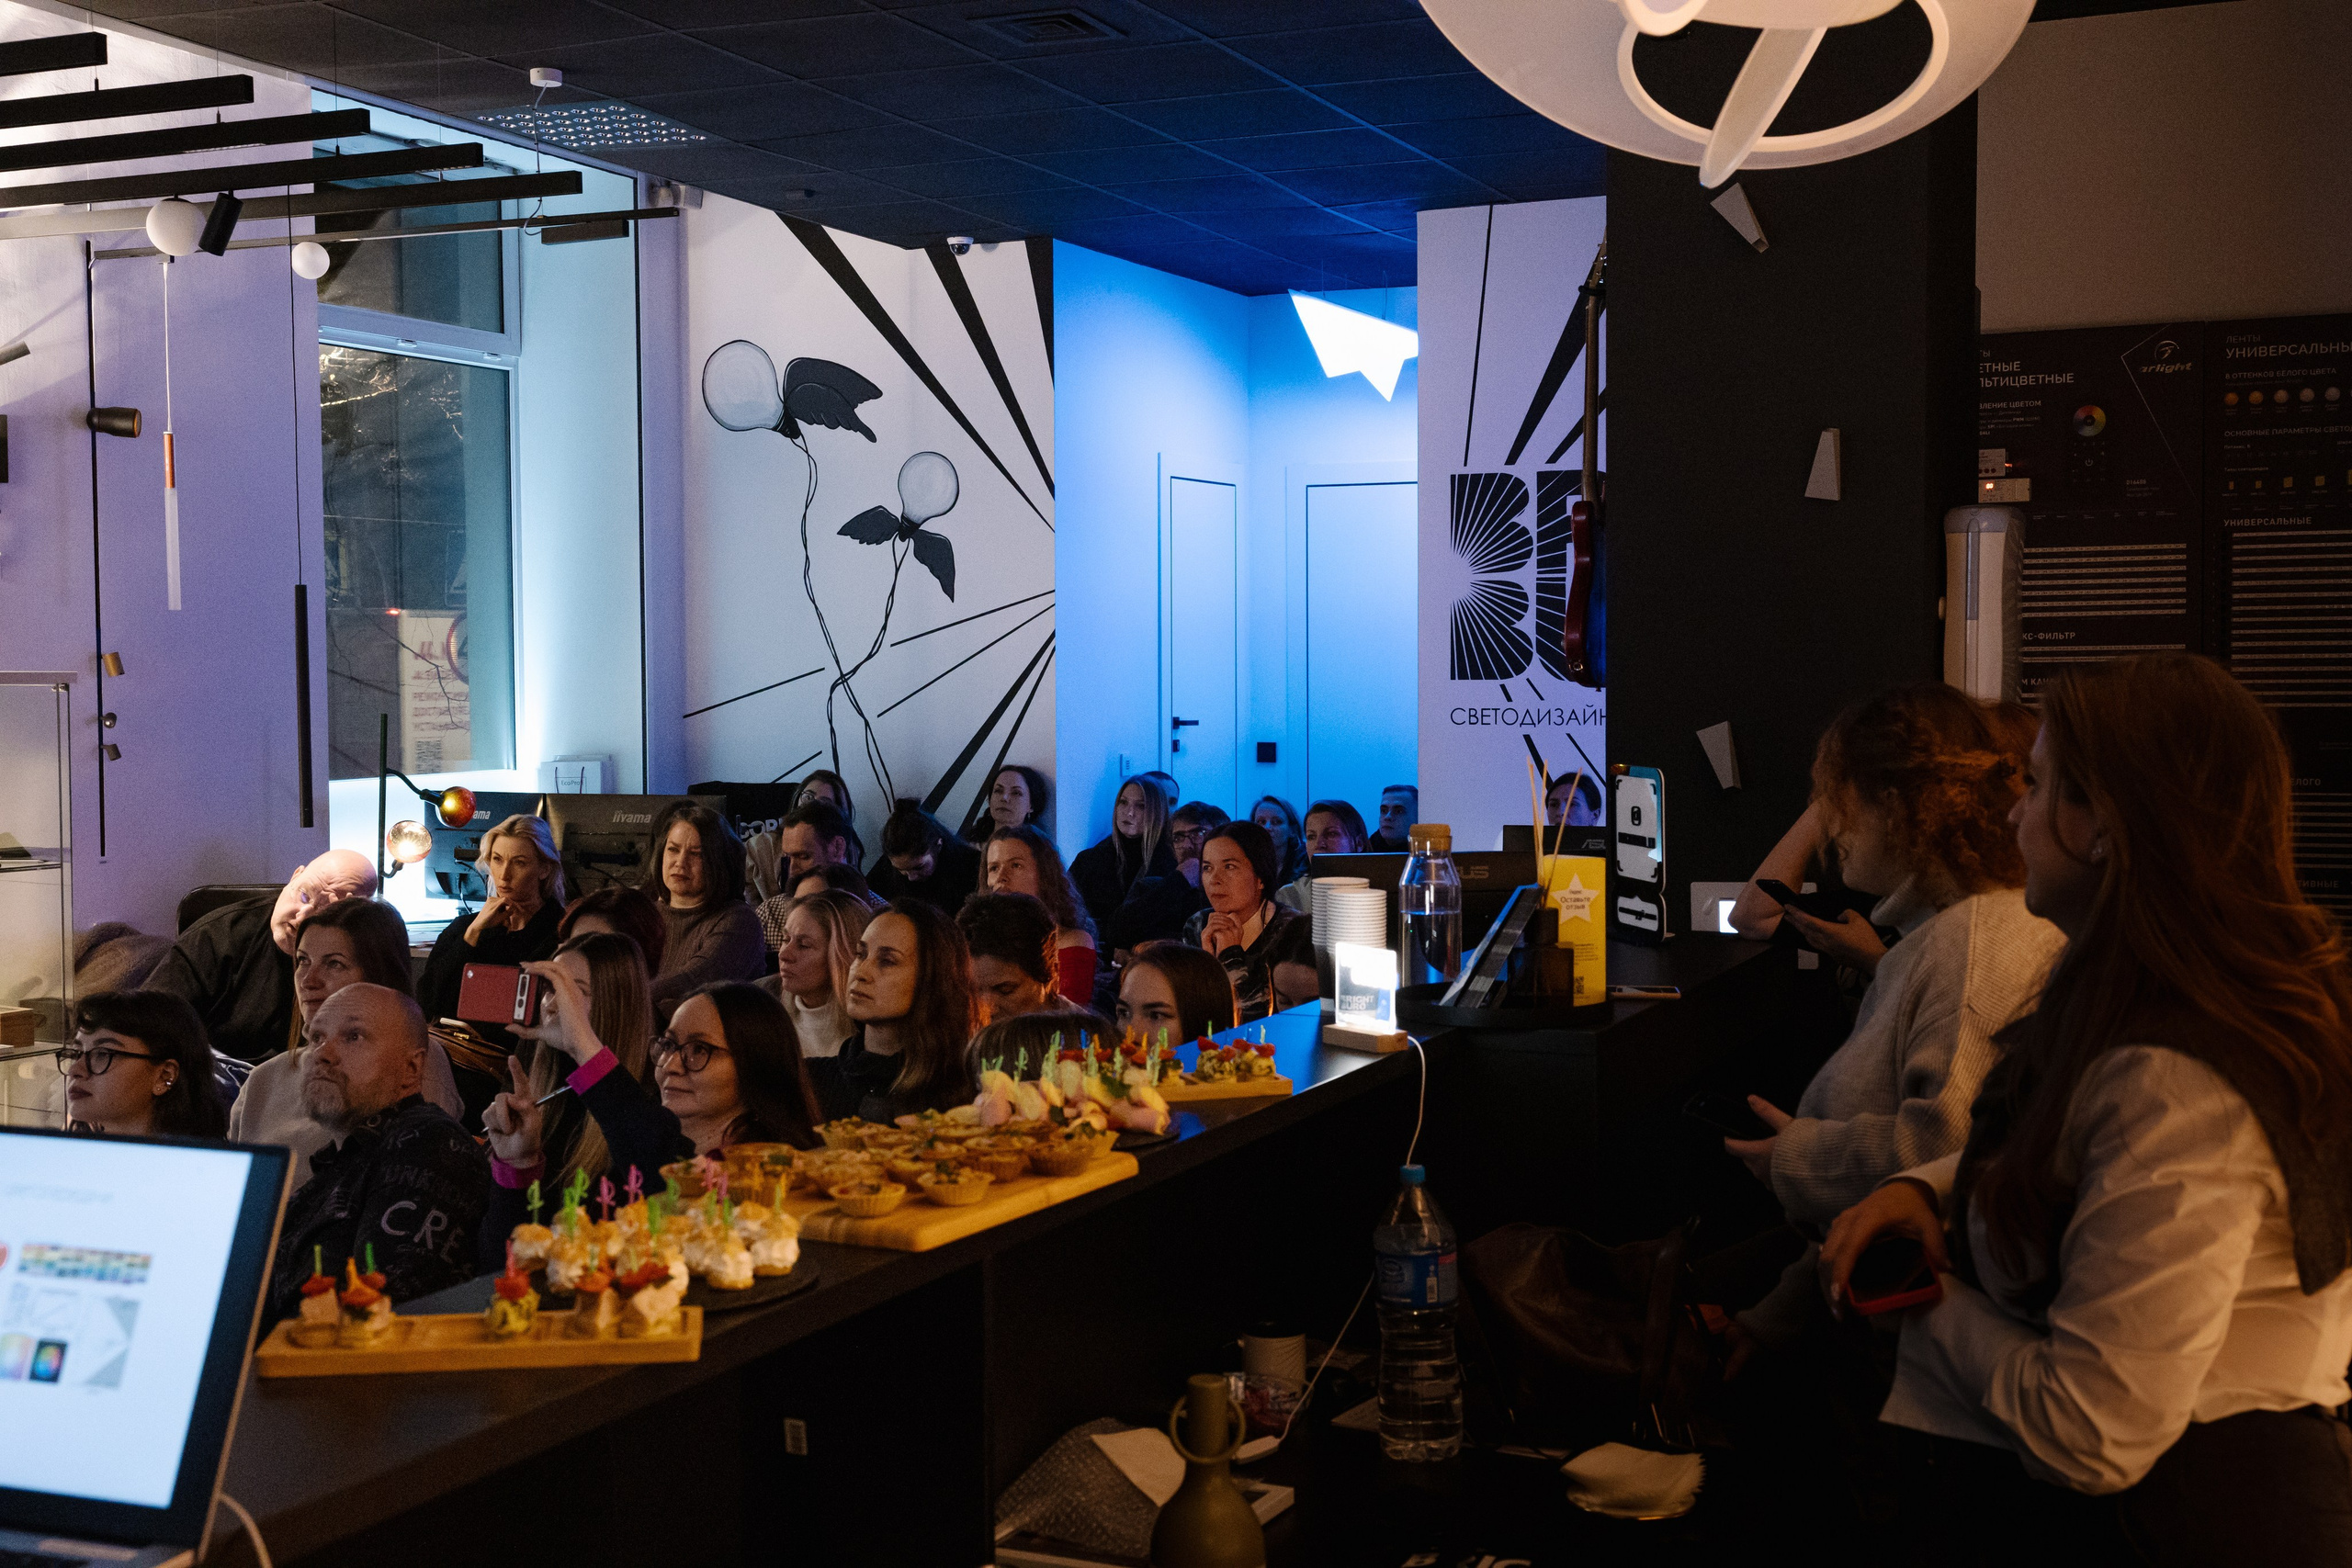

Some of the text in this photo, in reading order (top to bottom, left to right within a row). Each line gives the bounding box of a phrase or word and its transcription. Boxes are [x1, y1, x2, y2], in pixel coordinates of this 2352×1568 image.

[2225, 334, 2261, 344] ЛЕНТЫ
[2140, 361, 2193, 374] arlight
[2231, 370, 2275, 379] ОТТЕНКОВ
[2276, 369, 2308, 378] БЕЛОГО
[2309, 367, 2337, 377] ЦВЕТА
[2009, 400, 2041, 409] ЦВЕТОМ
[2223, 424, 2352, 437] ОСНОВНЫЕ ПАРАМЕТРЫ СВЕТО
[2223, 516, 2312, 527] УНИВЕРСАЛЬНЫЕ
[612, 809, 652, 824] iiyama
[1456, 865, 1489, 880] US
